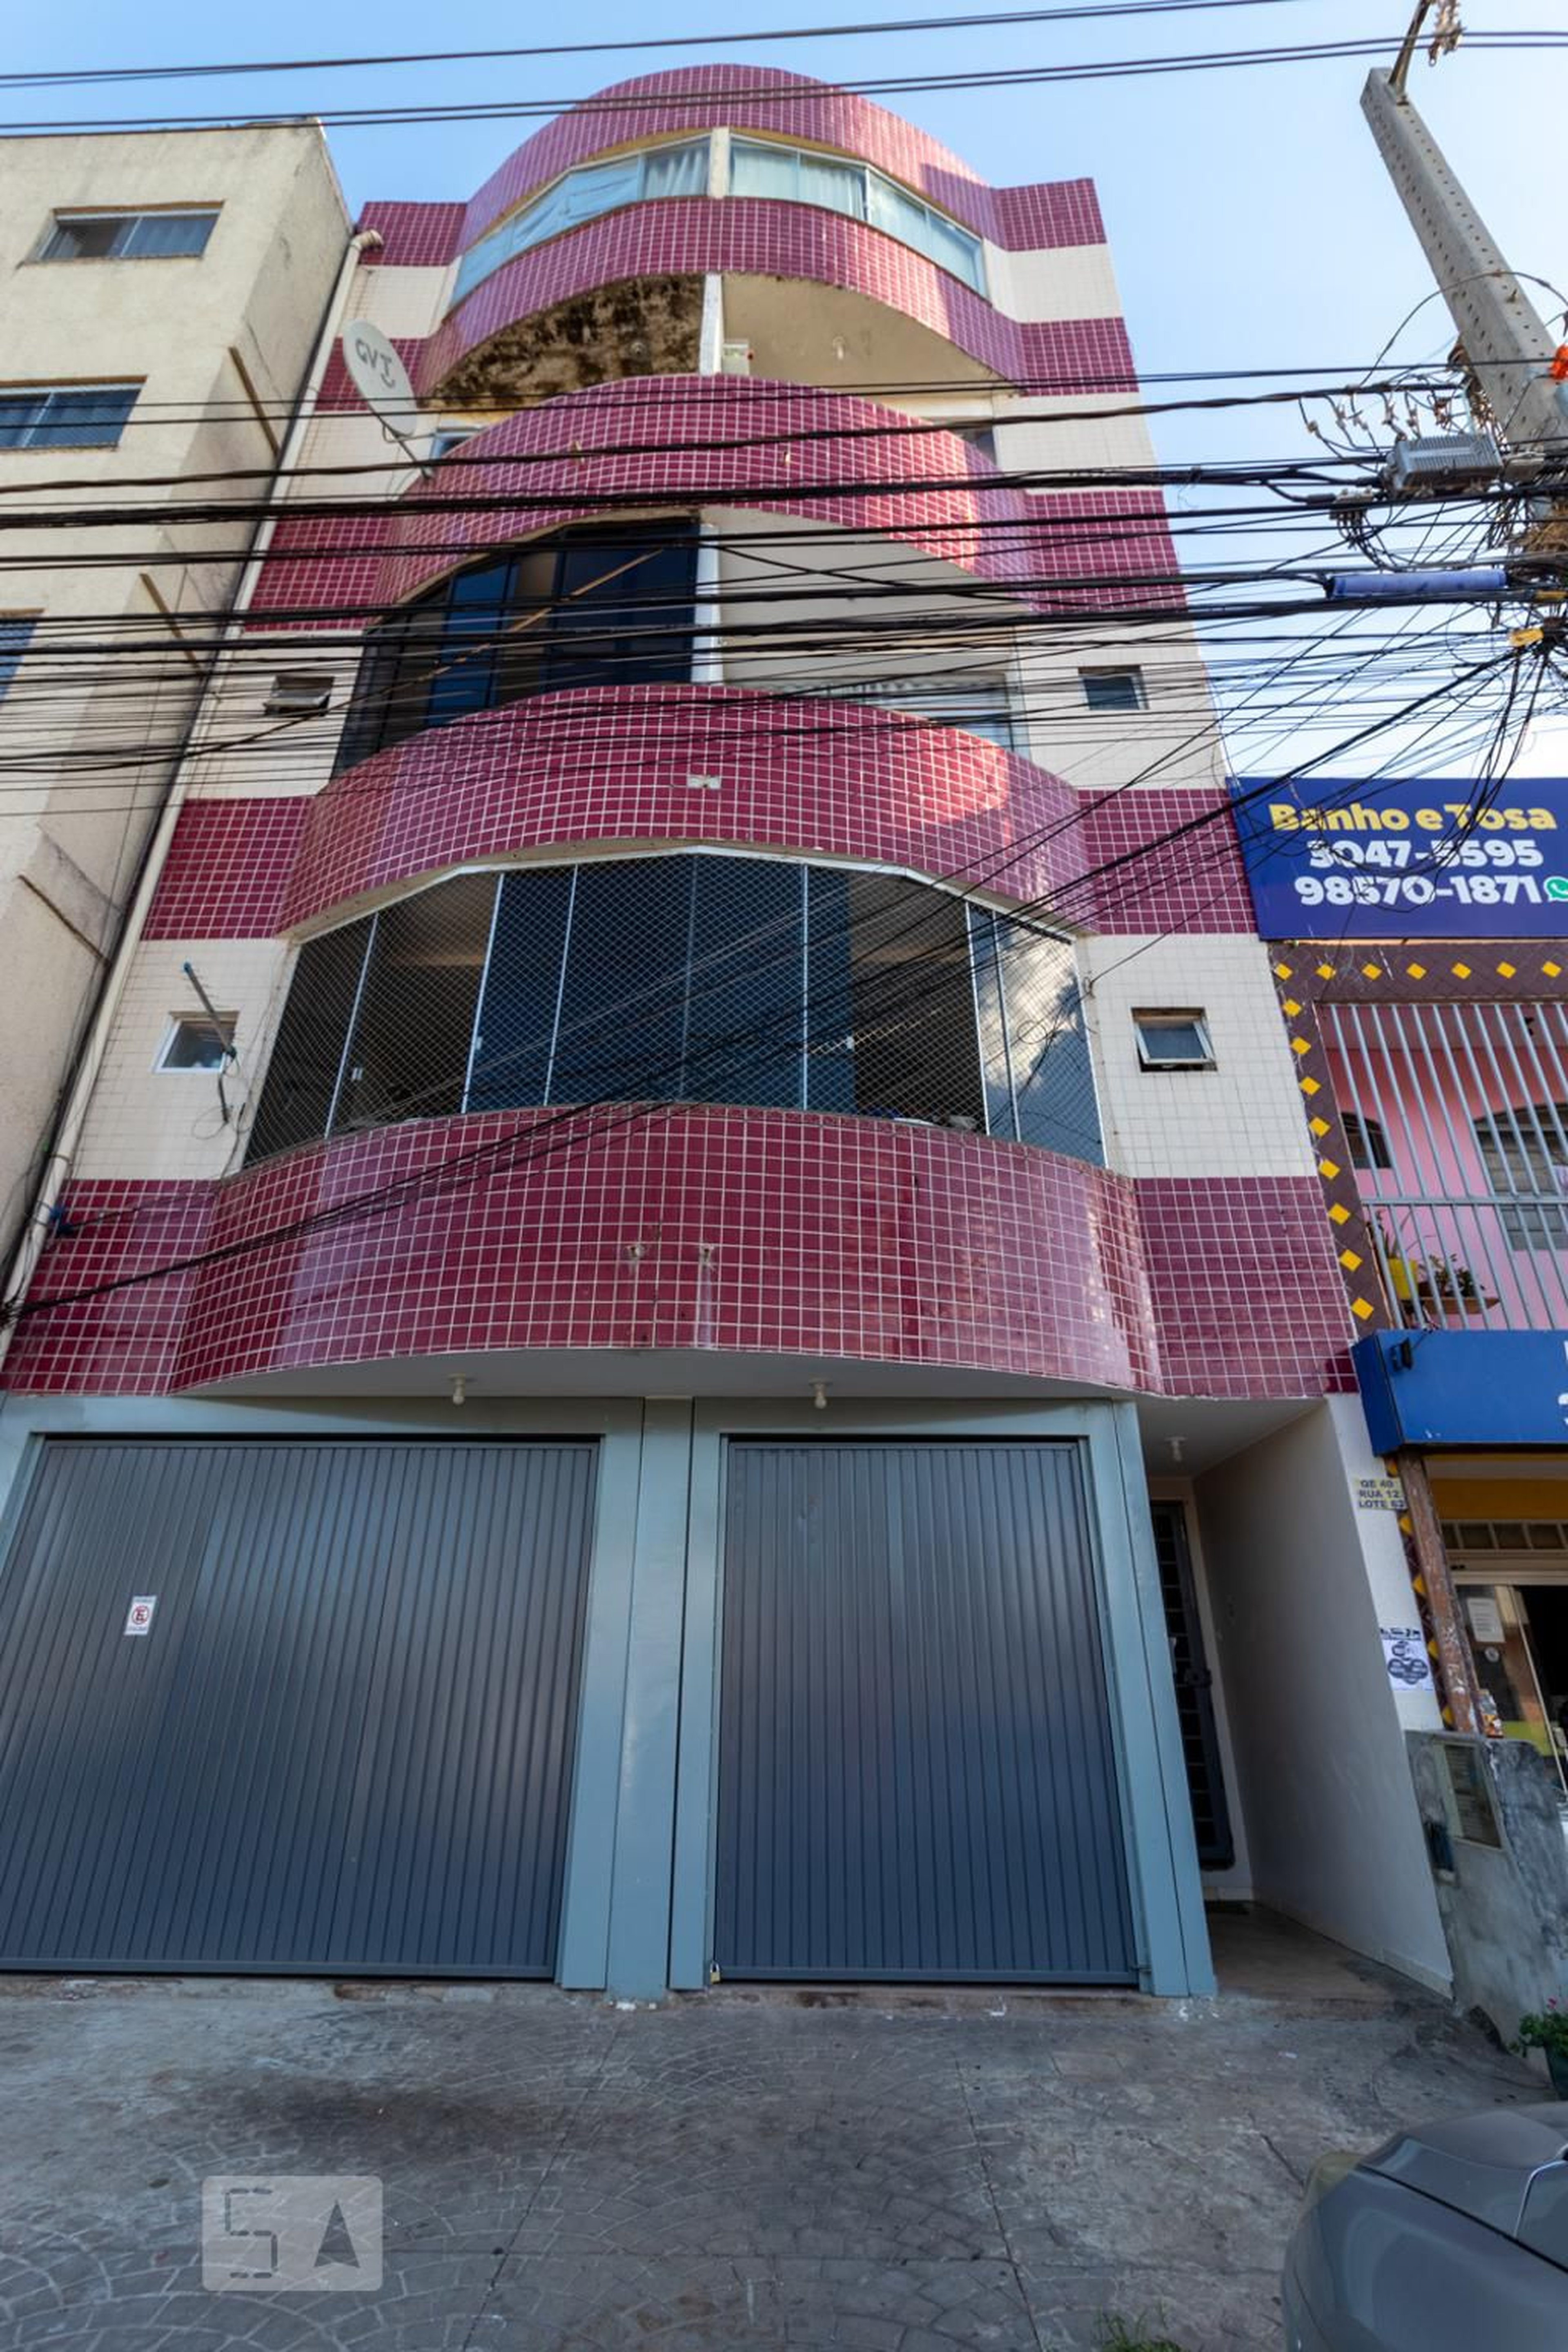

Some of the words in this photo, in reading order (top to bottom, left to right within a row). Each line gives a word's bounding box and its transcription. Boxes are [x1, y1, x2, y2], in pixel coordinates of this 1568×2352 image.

[1268, 802, 1410, 831] Banho
[1415, 808, 1443, 831] e
[1443, 804, 1557, 831] Tosa
[1294, 875, 1542, 906] 98570-1871
[1359, 1490, 1383, 1498] RUA
[1359, 1499, 1385, 1508] LOTE
